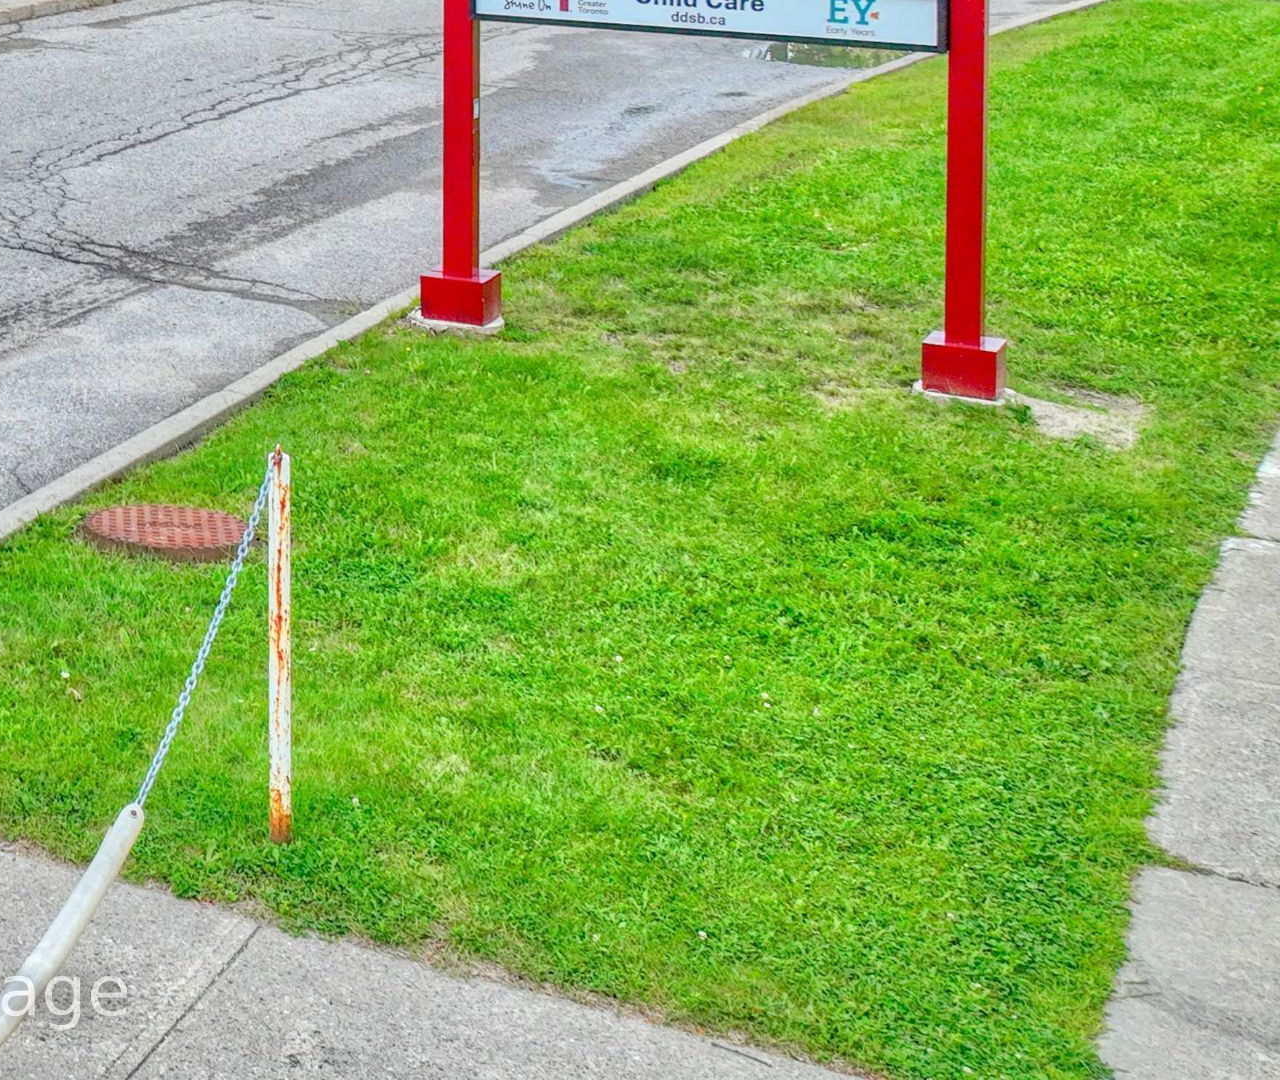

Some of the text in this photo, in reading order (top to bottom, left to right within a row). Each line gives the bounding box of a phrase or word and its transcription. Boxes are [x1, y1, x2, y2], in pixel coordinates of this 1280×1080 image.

[577, 0, 608, 8] Greater
[578, 7, 609, 15] Toronto
[671, 11, 726, 26] ddsb.ca
[826, 26, 876, 36] Early Years
